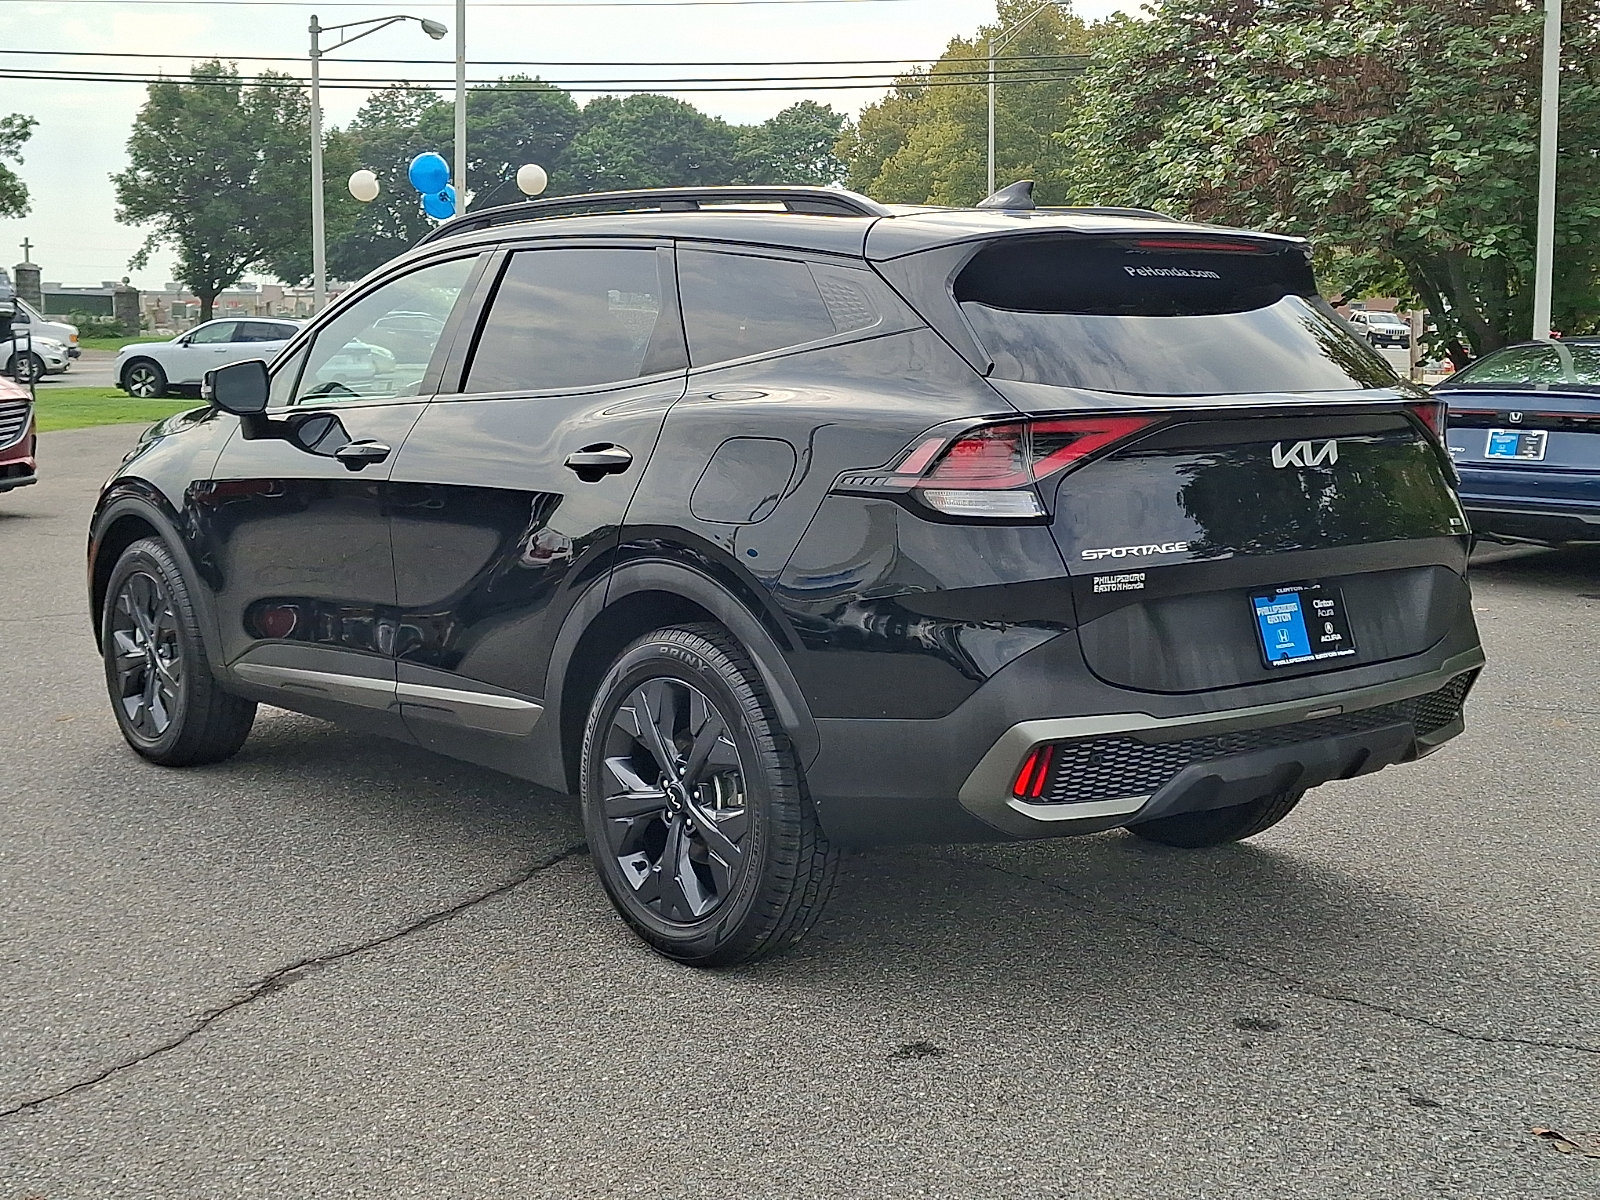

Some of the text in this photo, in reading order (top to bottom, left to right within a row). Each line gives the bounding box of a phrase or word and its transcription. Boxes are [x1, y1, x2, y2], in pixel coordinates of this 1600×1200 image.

[1123, 265, 1221, 279] PeHonda.com
[1271, 439, 1339, 469] KIA
[1081, 541, 1189, 560] SPORTAGE
[1122, 582, 1145, 591] Honda
[1313, 600, 1334, 608] Clinton
[1321, 634, 1342, 642] ACURA
[659, 646, 709, 673] PRINX
